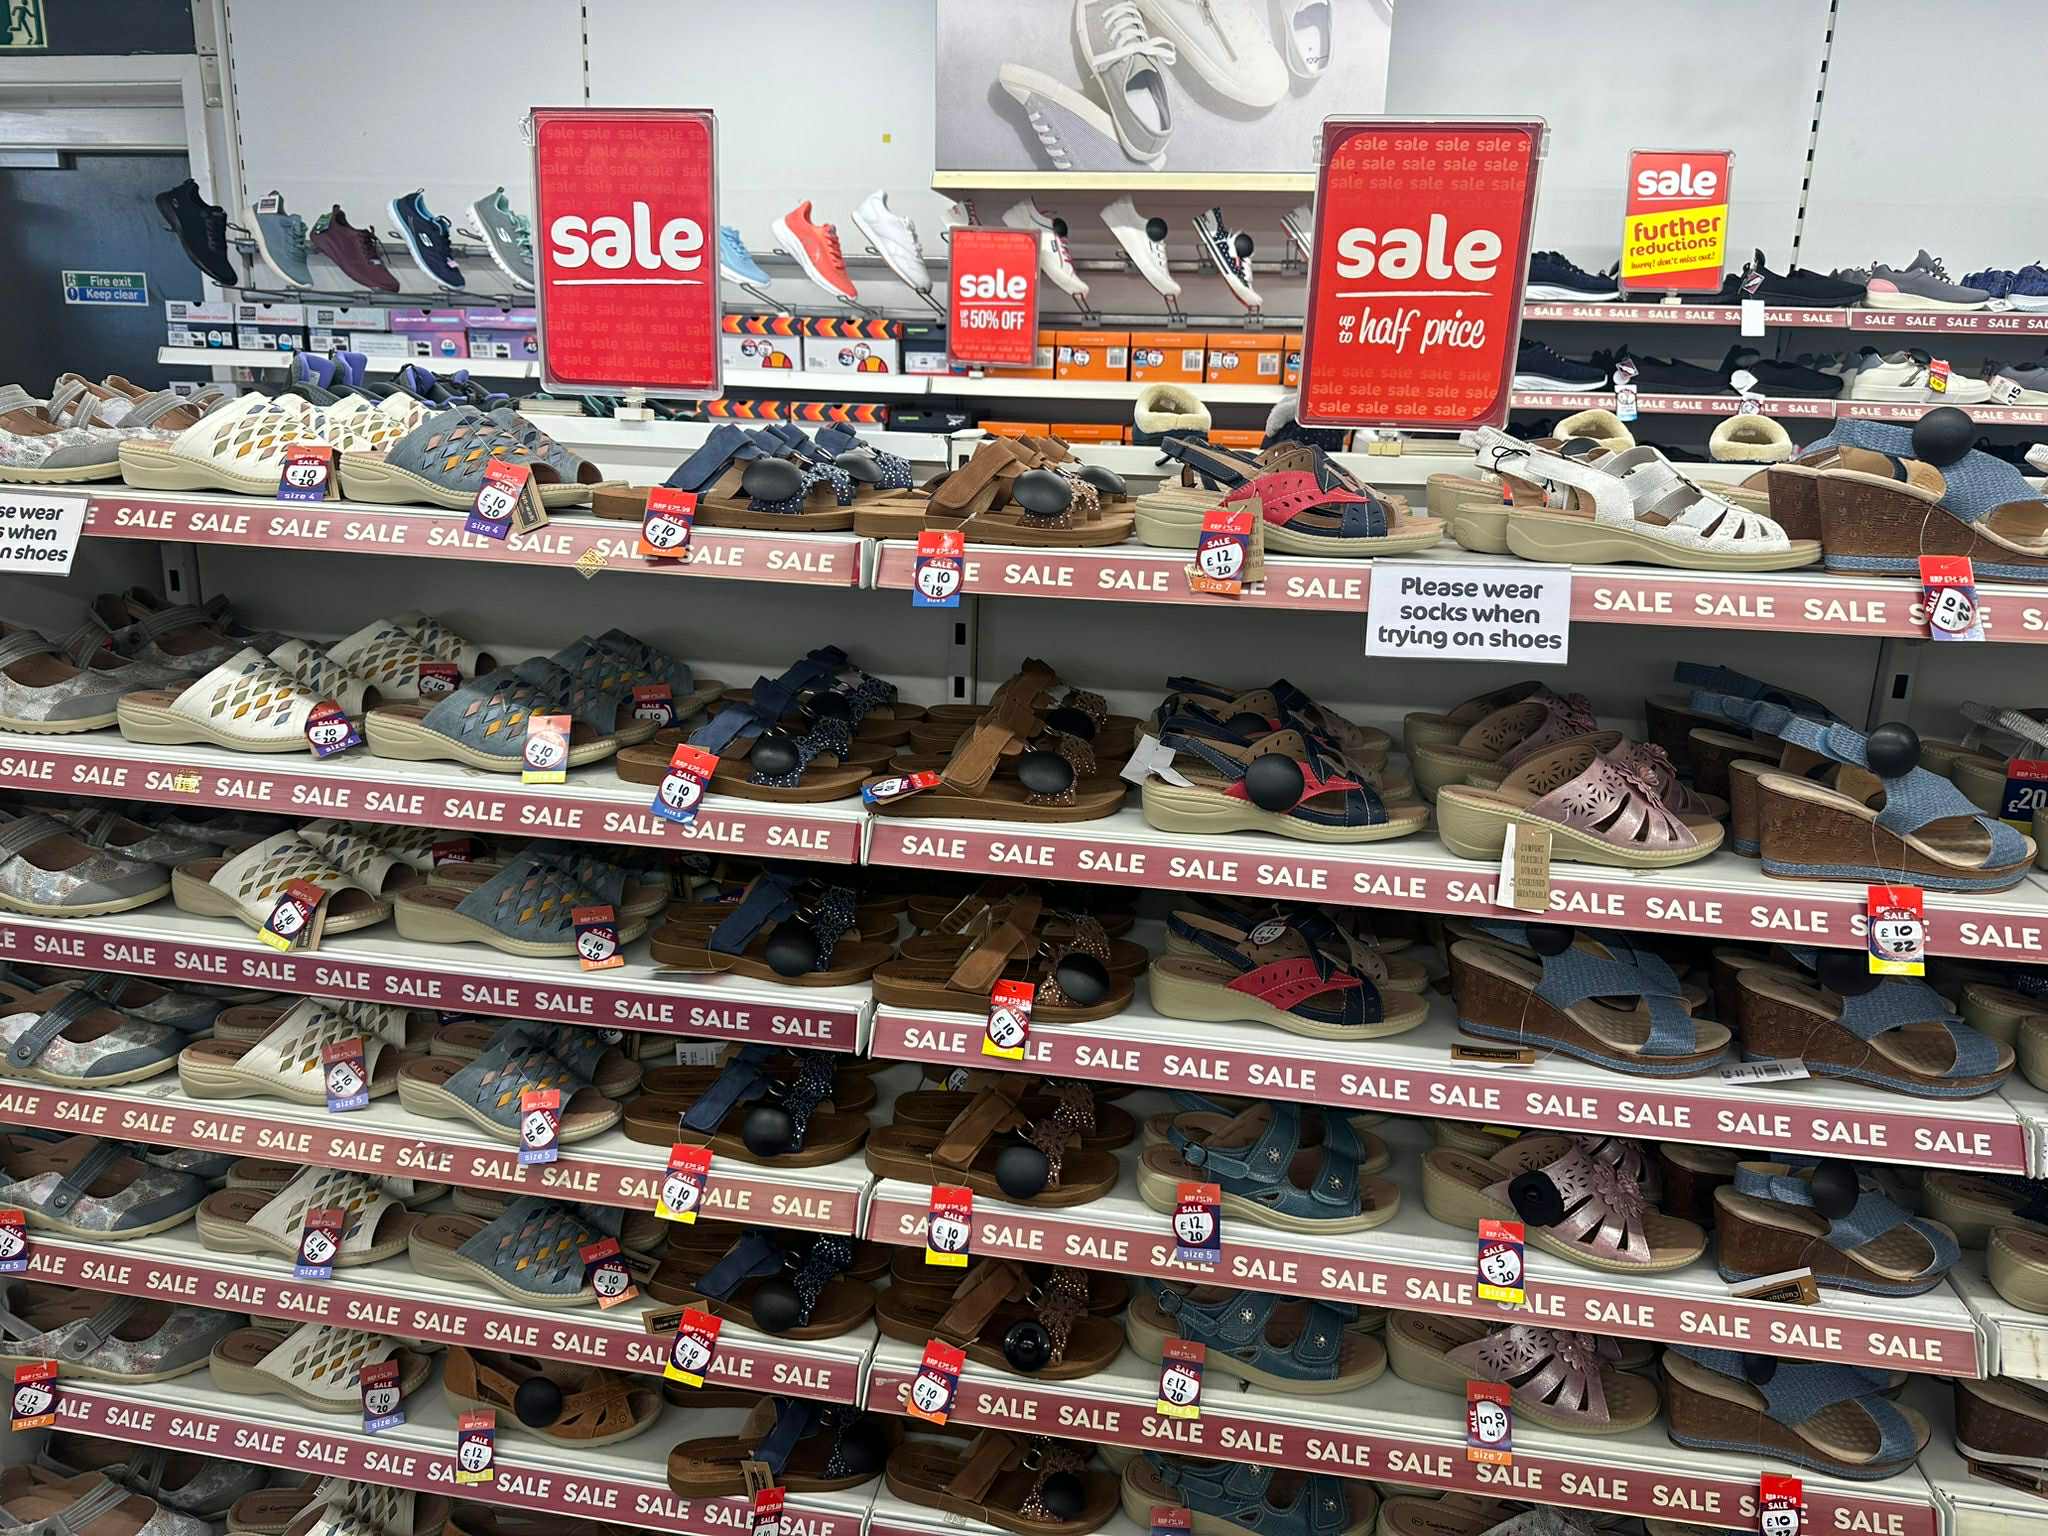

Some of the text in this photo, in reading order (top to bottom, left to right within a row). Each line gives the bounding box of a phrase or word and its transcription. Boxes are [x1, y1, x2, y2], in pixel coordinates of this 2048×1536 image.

[1354, 136, 1511, 152] sale sale sale sale
[1362, 157, 1518, 172] sale sale sale sale
[1637, 163, 1718, 196] sale
[551, 202, 704, 271] sale
[1634, 217, 1721, 242] further
[1336, 213, 1502, 281] sale
[1630, 237, 1717, 257] reductions
[1679, 255, 1697, 264] miss
[1698, 252, 1716, 262] out!
[90, 277, 131, 287] Fire exit
[960, 268, 1028, 300] sale
[87, 288, 138, 300] Keep clear
[970, 310, 1025, 330] 50% OFF
[1535, 307, 1714, 321] SALE SALE SALE
[1339, 315, 1355, 330] up
[1865, 316, 1977, 328] SALE SALE SALE
[1338, 330, 1353, 344] to
[1359, 306, 1486, 354] half price
[1319, 400, 1466, 416] sale sale sale sale
[1851, 406, 1881, 416] SALE
[494, 481, 514, 495] SALE
[284, 493, 308, 501] size
[20, 508, 63, 521] wear
[662, 514, 684, 526] SALE
[114, 507, 405, 544] SALE SALE SALE
[8, 526, 57, 541] when
[1207, 537, 1231, 549] SALE
[15, 546, 68, 562] shoes
[767, 549, 849, 574] SALE
[1097, 568, 1361, 600] SALE SALE
[1200, 581, 1224, 591] size
[1401, 577, 1543, 600] Please wear
[1593, 589, 1886, 624] SALE SALE SALE
[1926, 590, 1941, 613] SALE
[1401, 602, 1541, 624] socks when
[1378, 624, 1562, 650] trying on shoes
[318, 719, 339, 727] SALE
[675, 770, 697, 783] SALE
[0, 758, 583, 828] SALE SALE
[989, 842, 1830, 933] SALE SALE SALE SALE
[1884, 911, 1910, 920] SALE
[592, 928, 612, 938] SALE
[34, 935, 832, 1038] SALE SALE SALE SALE SALE SALE
[1012, 1008, 1027, 1027] SALE
[348, 1061, 365, 1077] SALE
[903, 1028, 1887, 1147] SALE SALE SALE SALE
[335, 1099, 354, 1108] size
[257, 1129, 382, 1162] SALE SALE
[522, 1153, 543, 1162] size
[943, 1211, 964, 1222] SALE
[1182, 1205, 1202, 1213] SALE
[1184, 1249, 1203, 1259] size
[1483, 1245, 1505, 1256] SALE
[1064, 1234, 1656, 1328] SALE SALE
[81, 1261, 831, 1389] SALE SALE SALE SALE
[1176, 1364, 1197, 1378] SALE
[31, 1382, 50, 1392] SALE
[17, 1419, 38, 1428] size
[105, 1407, 690, 1519] SALE SALE SALE SALE
[1306, 1439, 1721, 1514] SALE SALE
[1768, 1501, 1788, 1510] SALE
